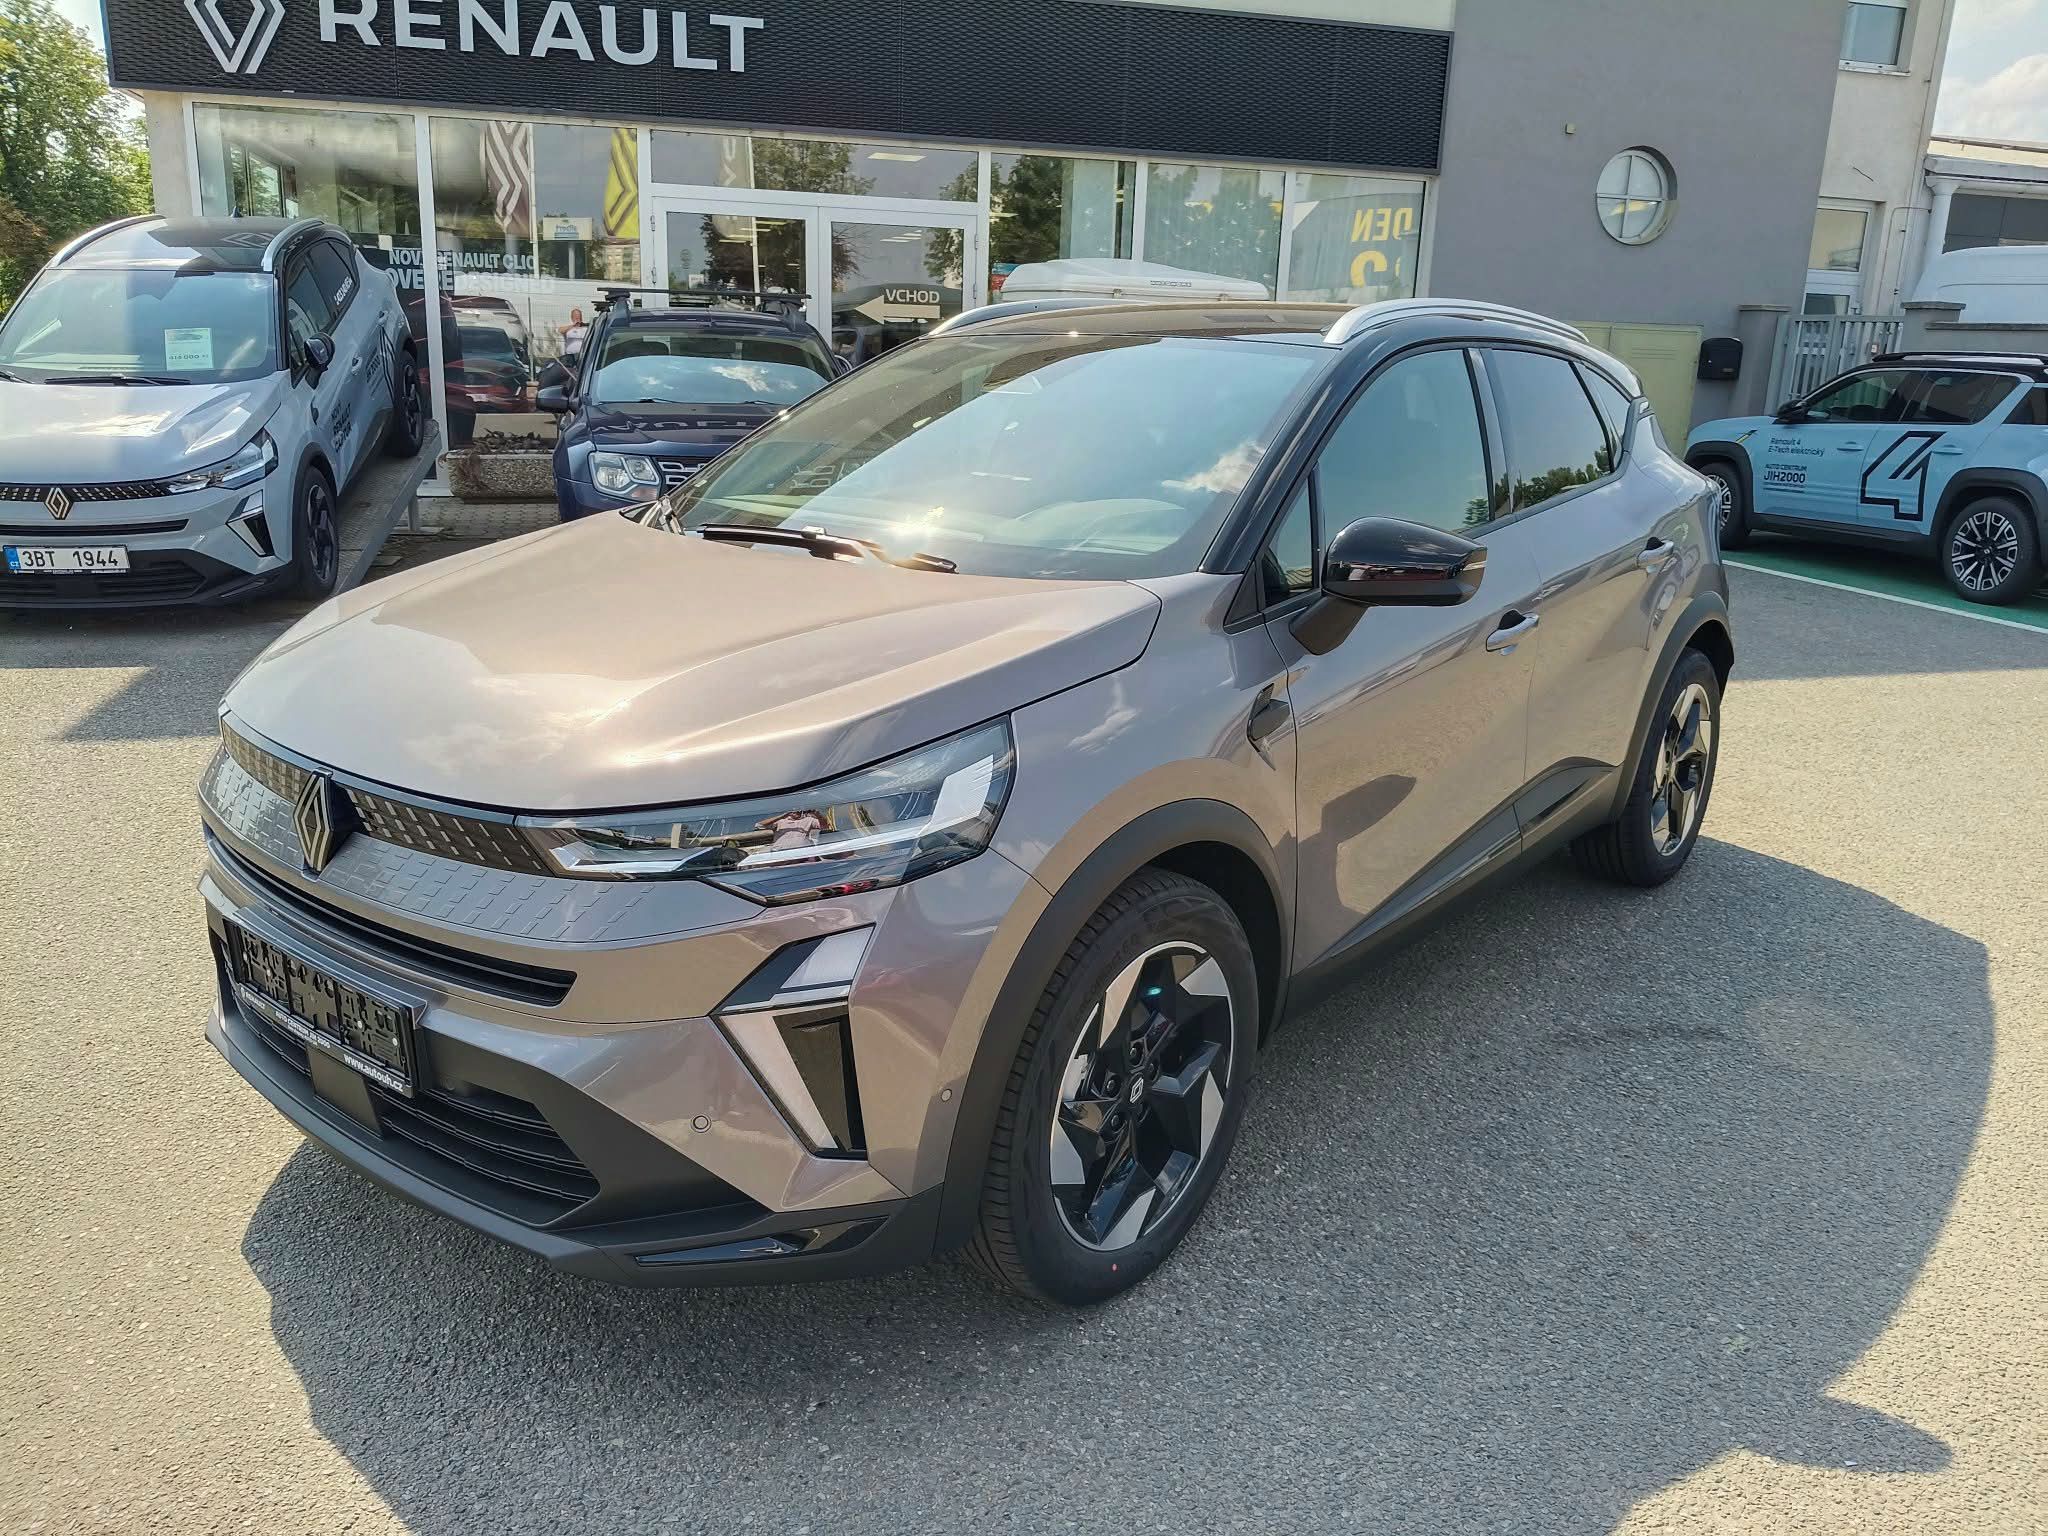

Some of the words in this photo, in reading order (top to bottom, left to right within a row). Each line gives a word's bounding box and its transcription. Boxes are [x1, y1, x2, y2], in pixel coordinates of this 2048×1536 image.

[318, 0, 765, 73] RENAULT
[885, 288, 941, 304] VCHOD
[1763, 470, 1806, 483] JIH2000
[22, 550, 55, 567] 3BT
[72, 550, 118, 567] 1944
[343, 1053, 404, 1093] www.autouh.cz
